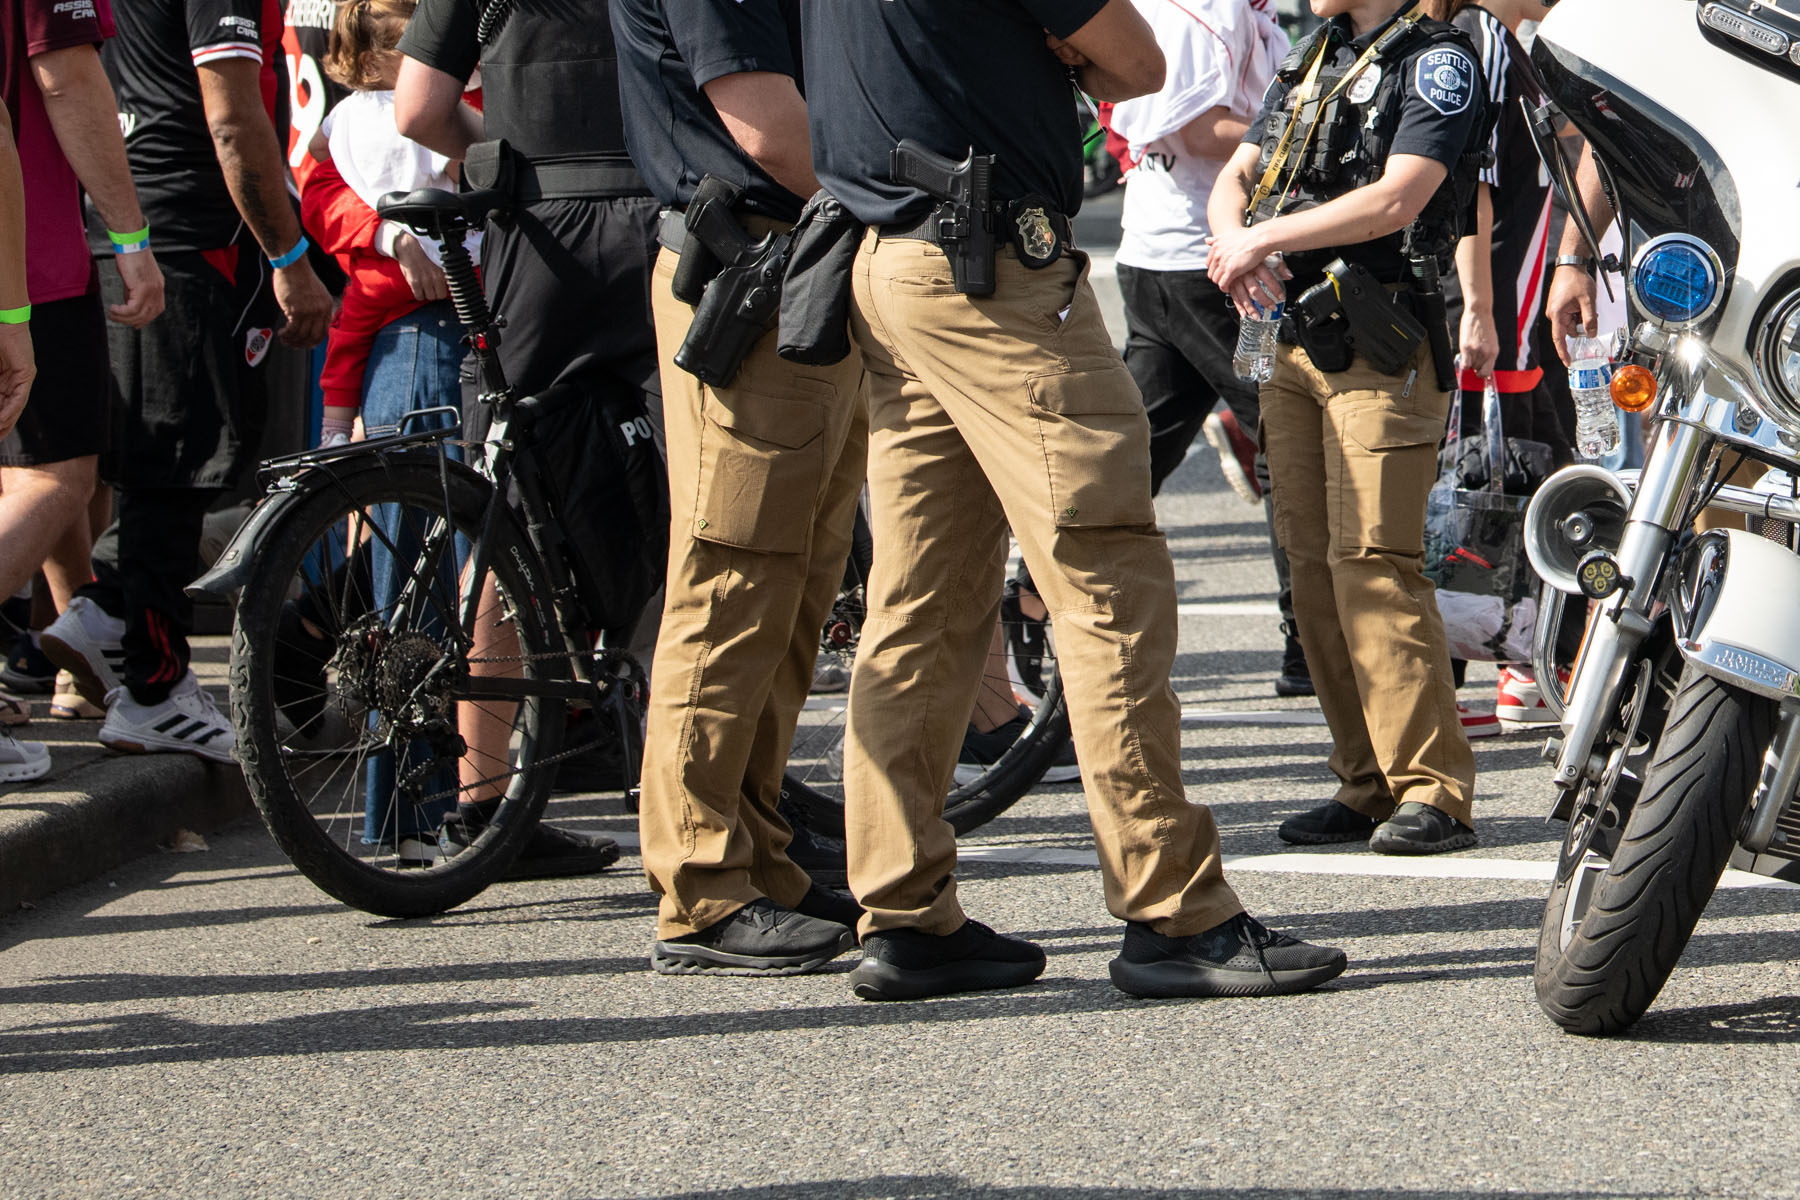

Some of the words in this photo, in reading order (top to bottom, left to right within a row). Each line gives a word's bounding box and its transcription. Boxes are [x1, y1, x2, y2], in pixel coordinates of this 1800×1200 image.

[53, 0, 93, 13] ASSIS
[1427, 53, 1468, 73] SEATTLE
[1430, 87, 1462, 107] POLICE
[620, 416, 652, 447] PO
